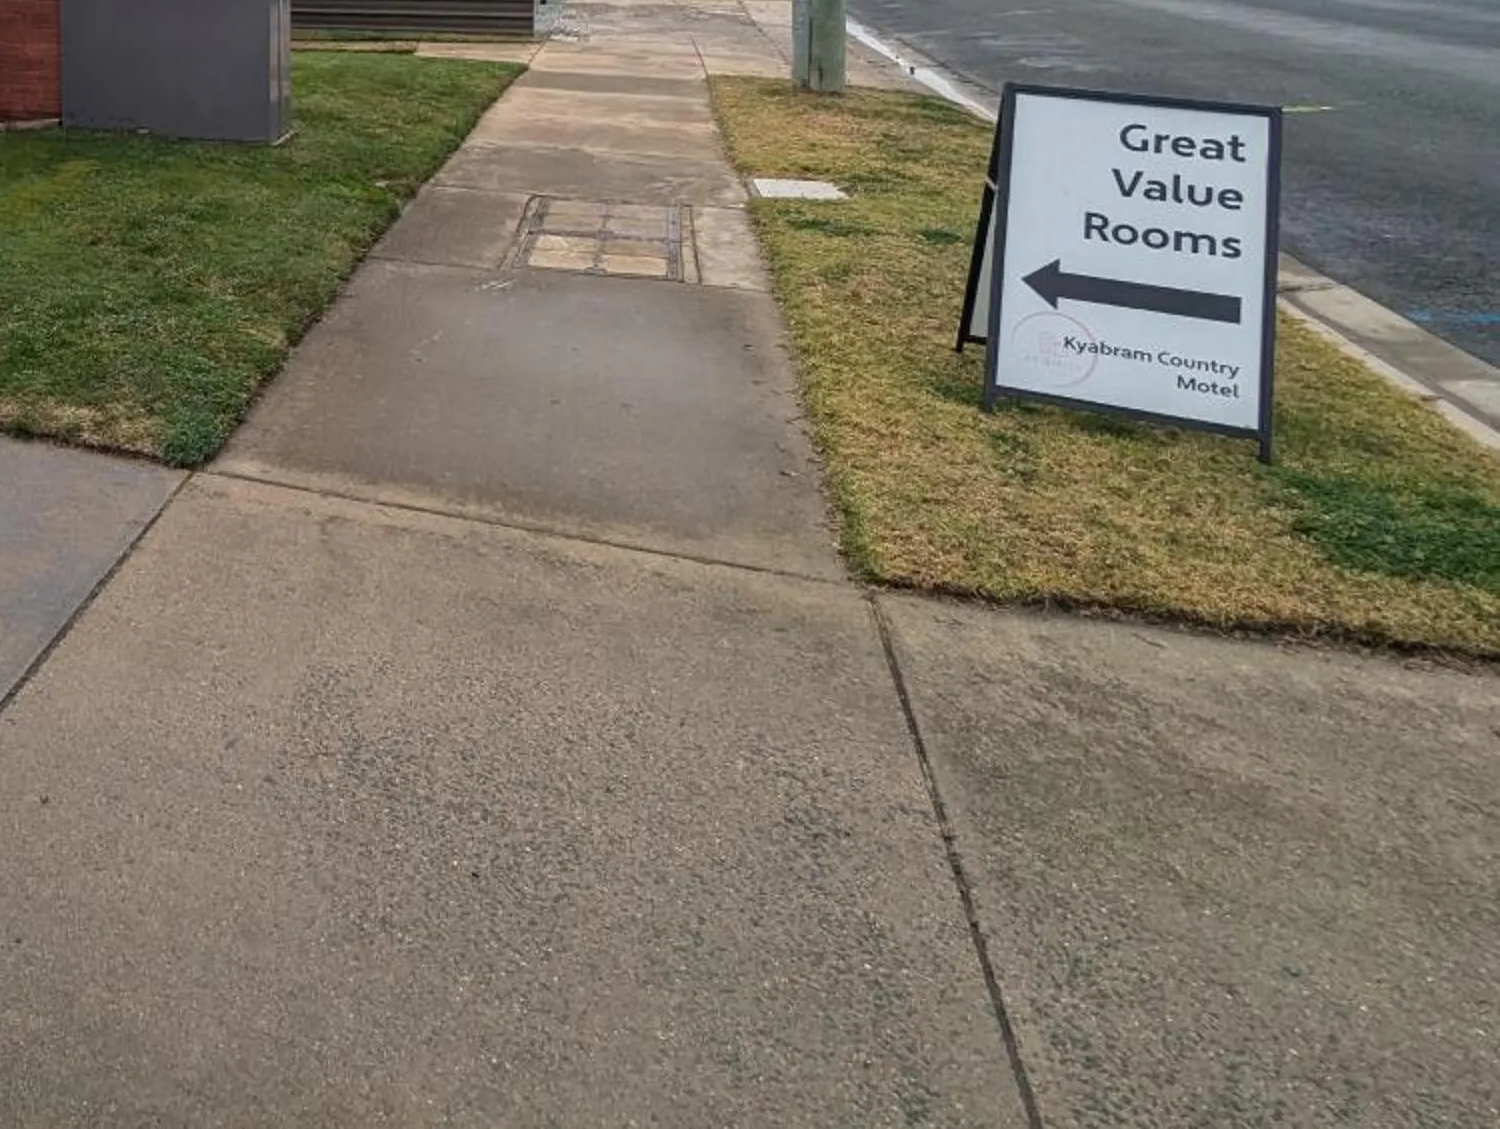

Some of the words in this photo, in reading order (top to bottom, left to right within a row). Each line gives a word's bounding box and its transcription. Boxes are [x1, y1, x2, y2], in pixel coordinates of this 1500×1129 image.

[1119, 123, 1247, 163] Great
[1111, 168, 1244, 210] Value
[1083, 211, 1242, 259] Rooms
[1063, 335, 1153, 363] Kyabram
[1158, 351, 1240, 378] Country
[1176, 375, 1239, 399] Motel
